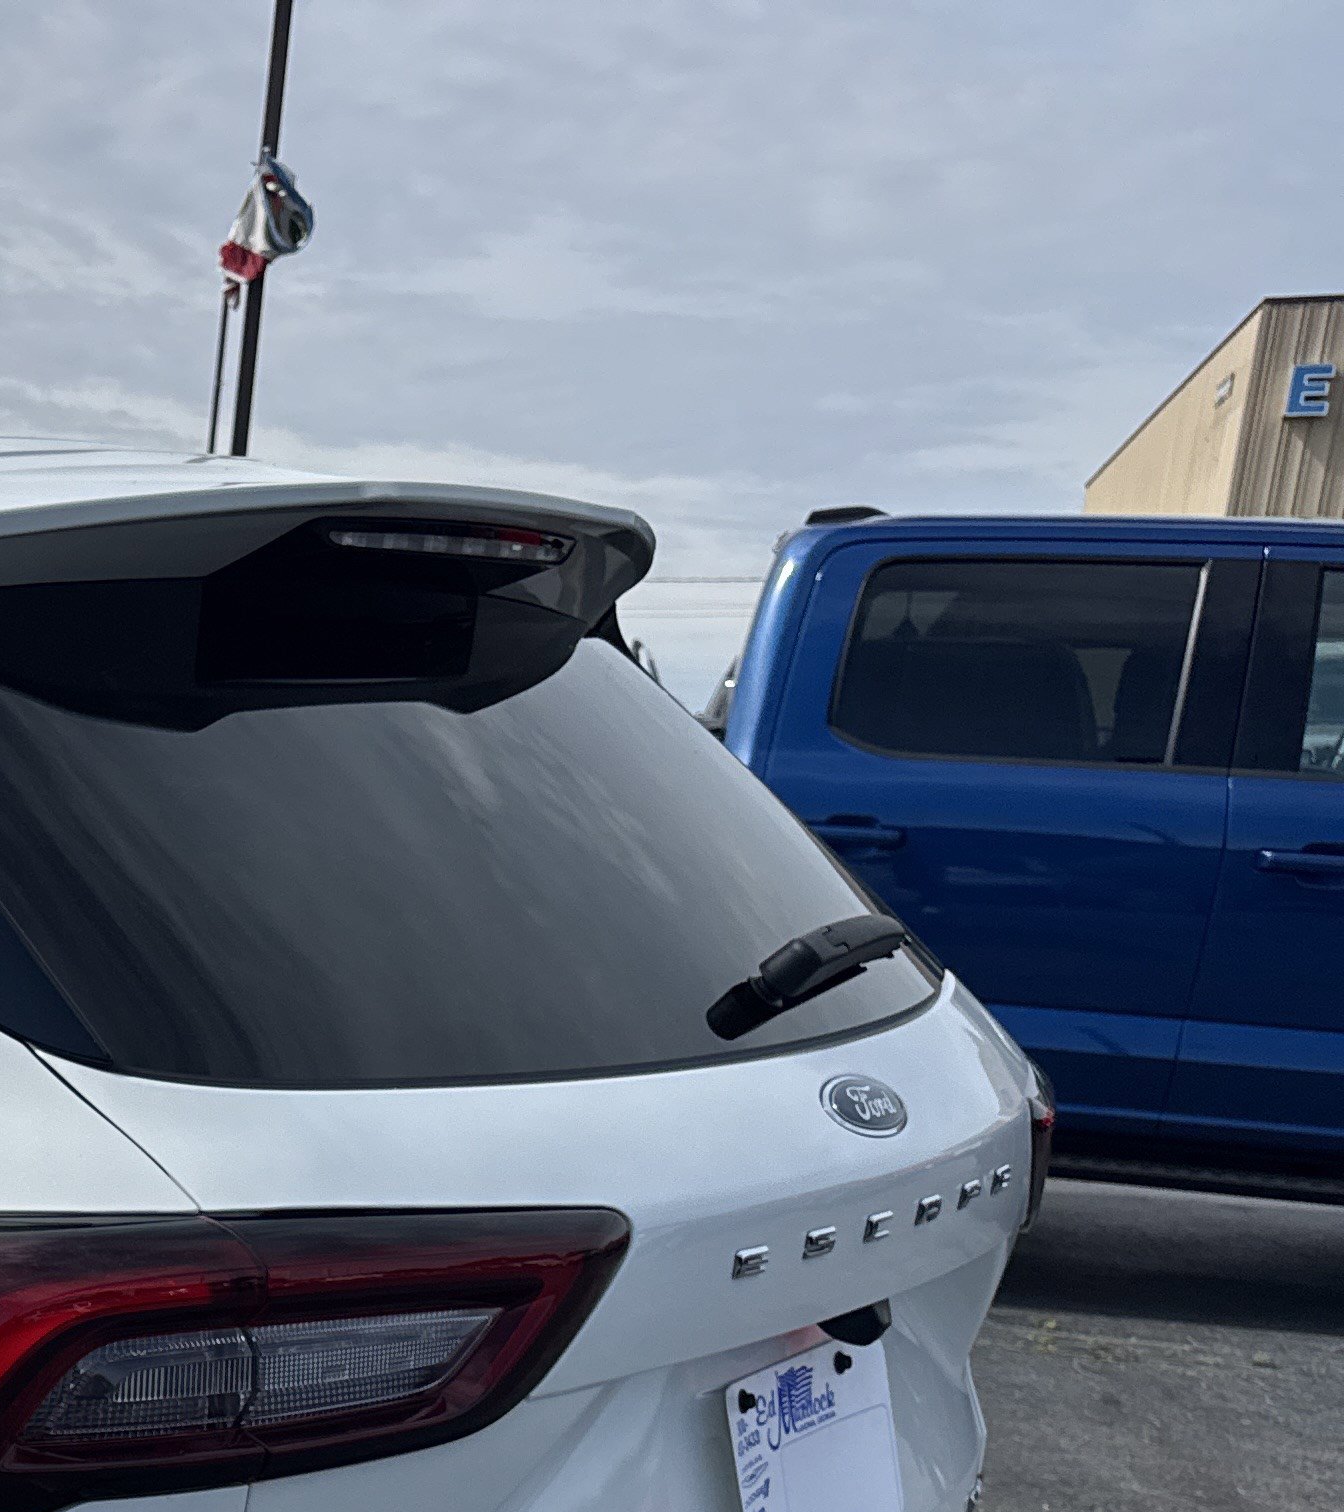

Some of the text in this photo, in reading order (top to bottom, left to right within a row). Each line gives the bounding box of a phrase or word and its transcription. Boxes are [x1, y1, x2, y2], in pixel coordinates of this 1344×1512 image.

[1284, 363, 1337, 417] E
[846, 1085, 898, 1122] Ford
[731, 1164, 1013, 1280] ESCAPE
